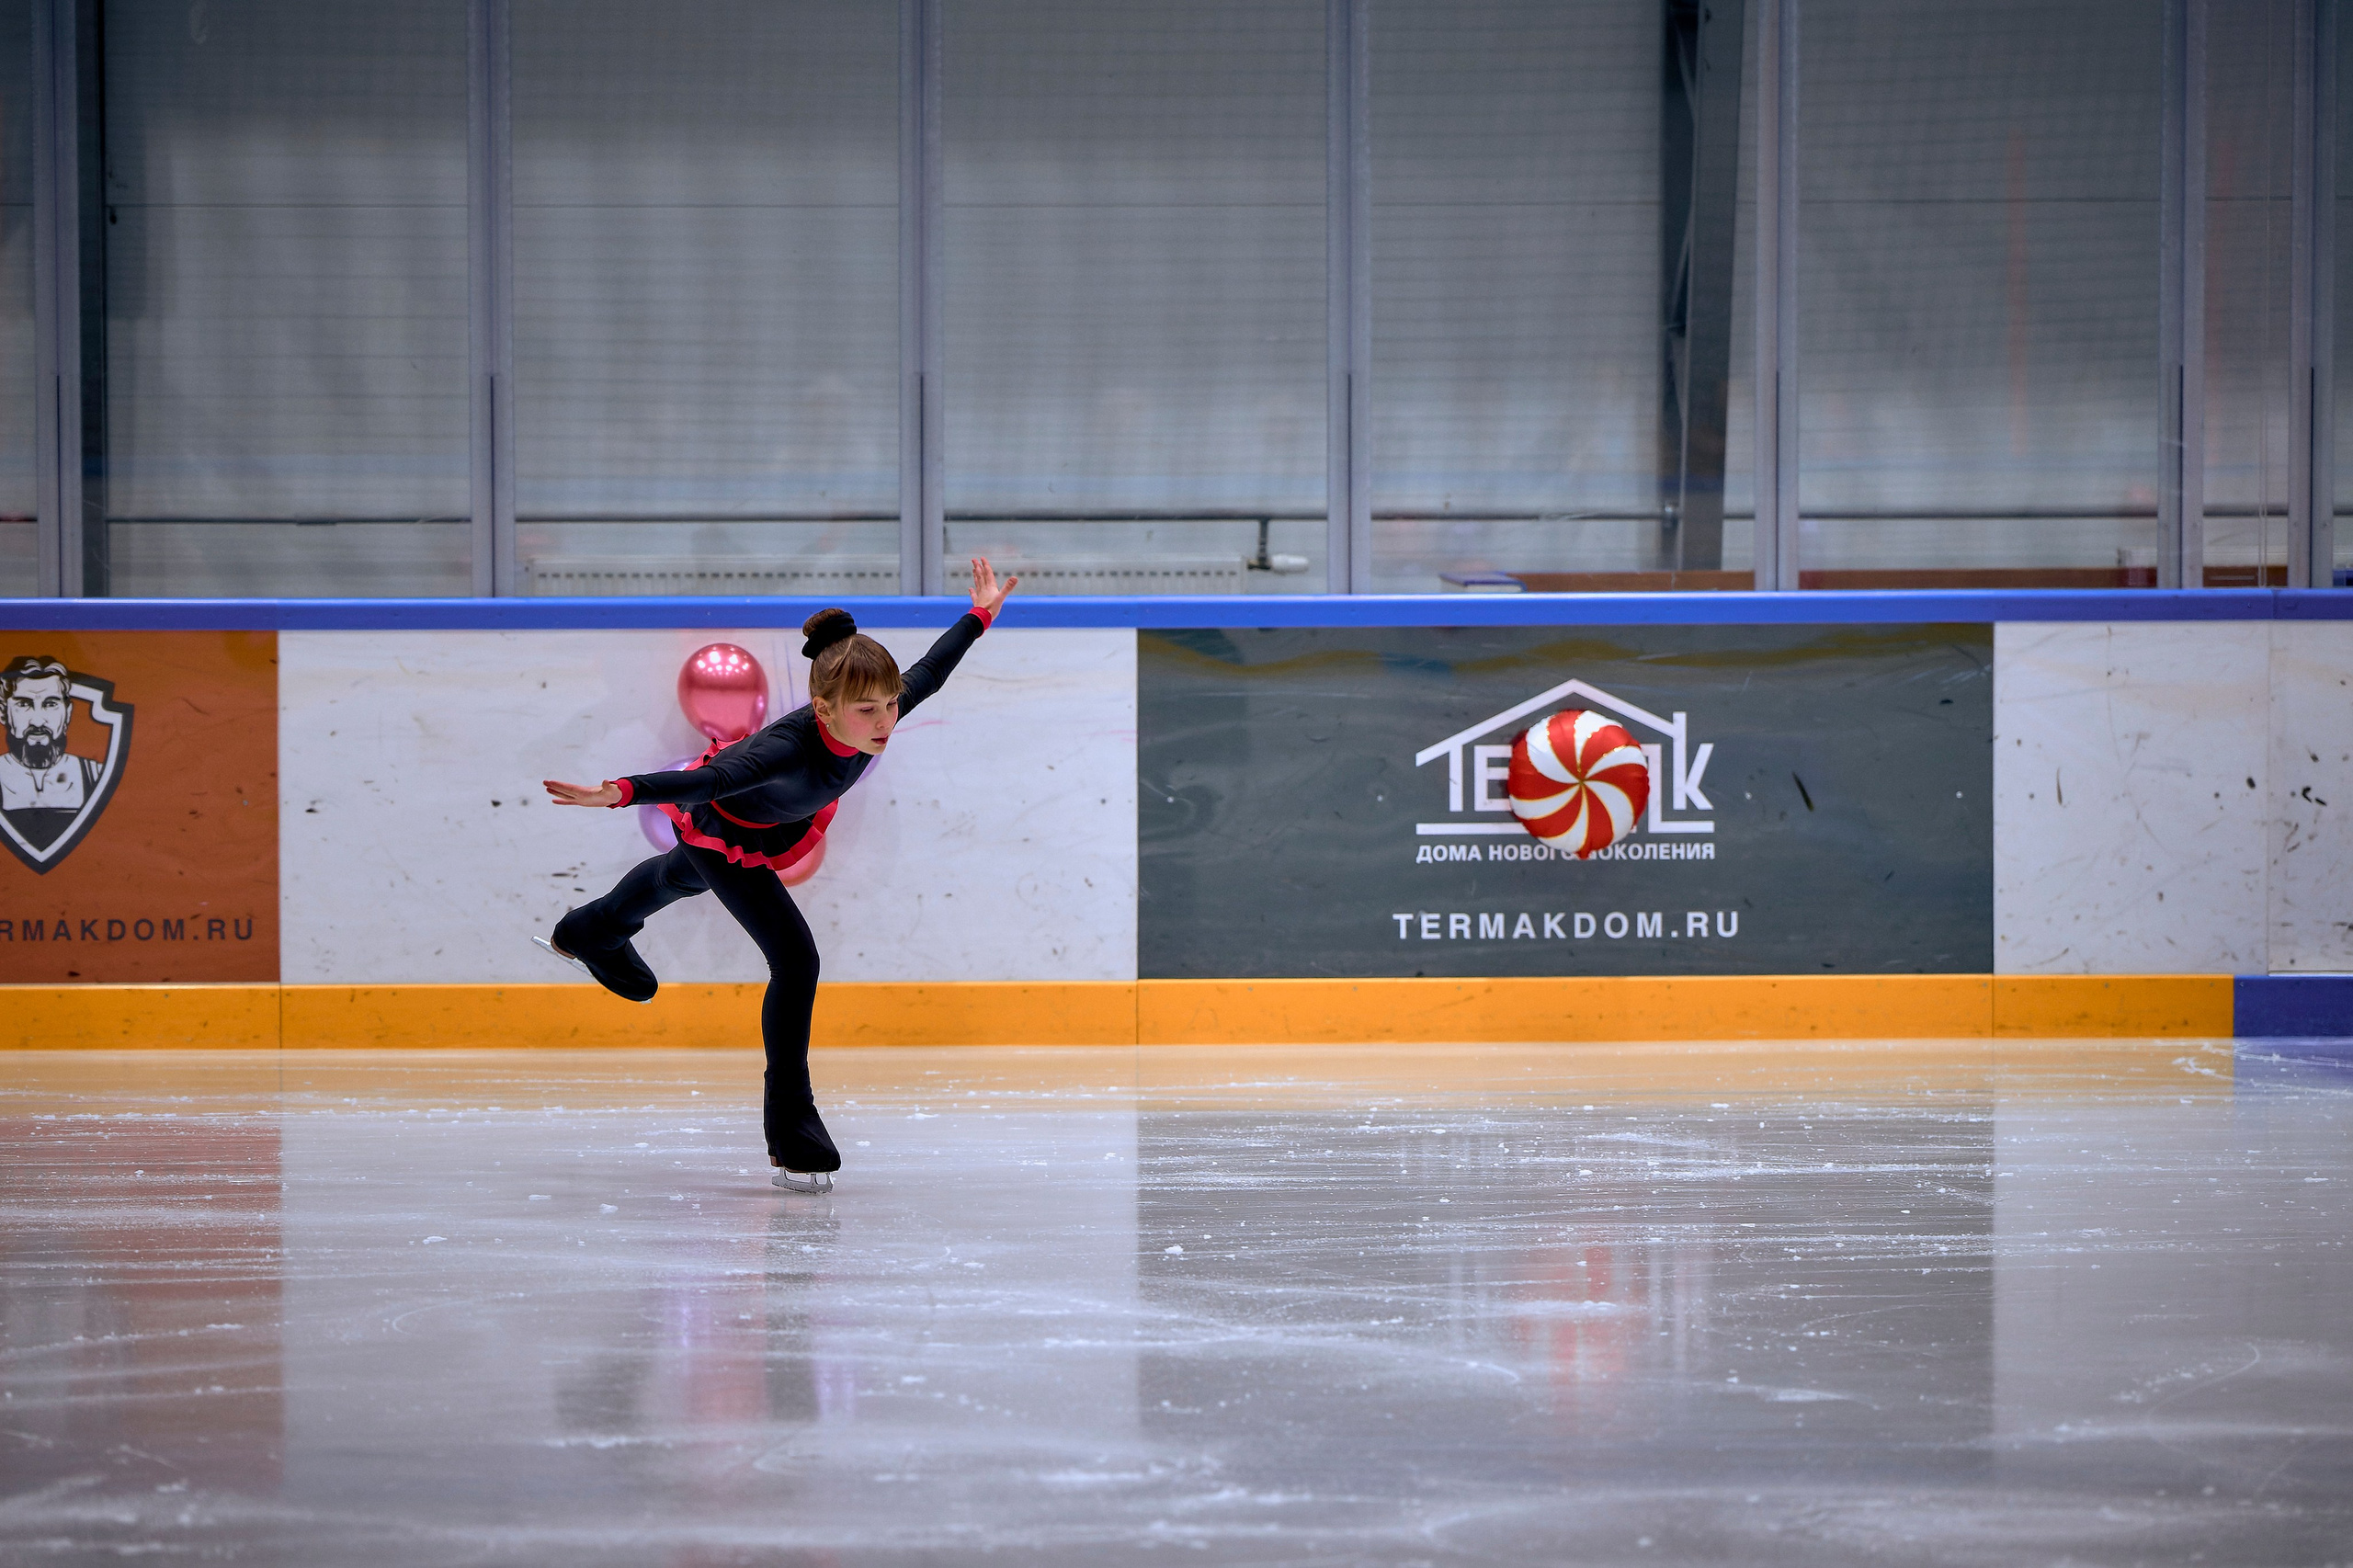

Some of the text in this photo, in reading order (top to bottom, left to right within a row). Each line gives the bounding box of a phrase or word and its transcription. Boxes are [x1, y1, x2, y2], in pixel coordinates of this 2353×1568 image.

[1415, 843, 1483, 864] ДОМА
[0, 918, 254, 941] RMAKDOM.RU
[1392, 910, 1740, 940] TERMAKDOM.RU
